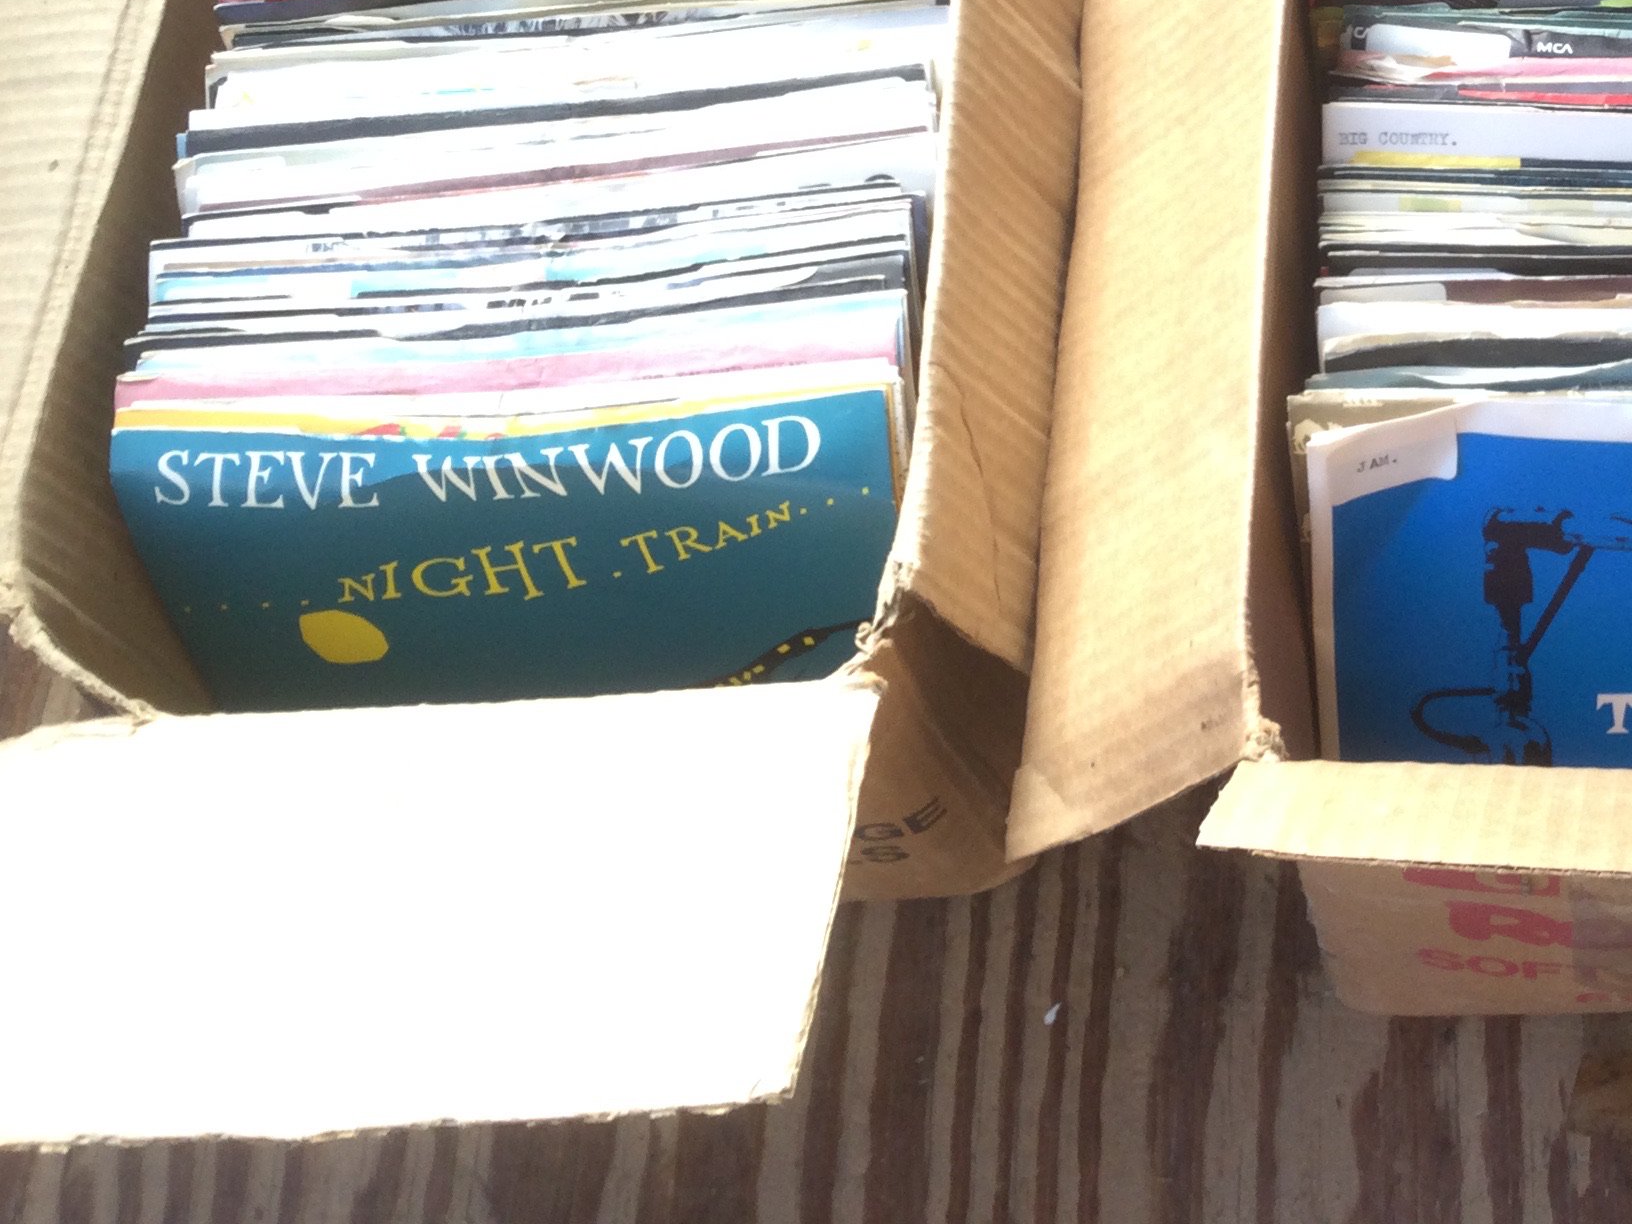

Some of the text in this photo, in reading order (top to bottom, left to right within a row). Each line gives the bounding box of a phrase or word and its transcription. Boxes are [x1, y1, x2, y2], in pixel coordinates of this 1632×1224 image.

[1535, 41, 1574, 55] MCA
[1338, 131, 1458, 147] BIG COUNTRY.
[154, 415, 822, 511] STEVE WINWOOD
[337, 536, 588, 602] NIGHT
